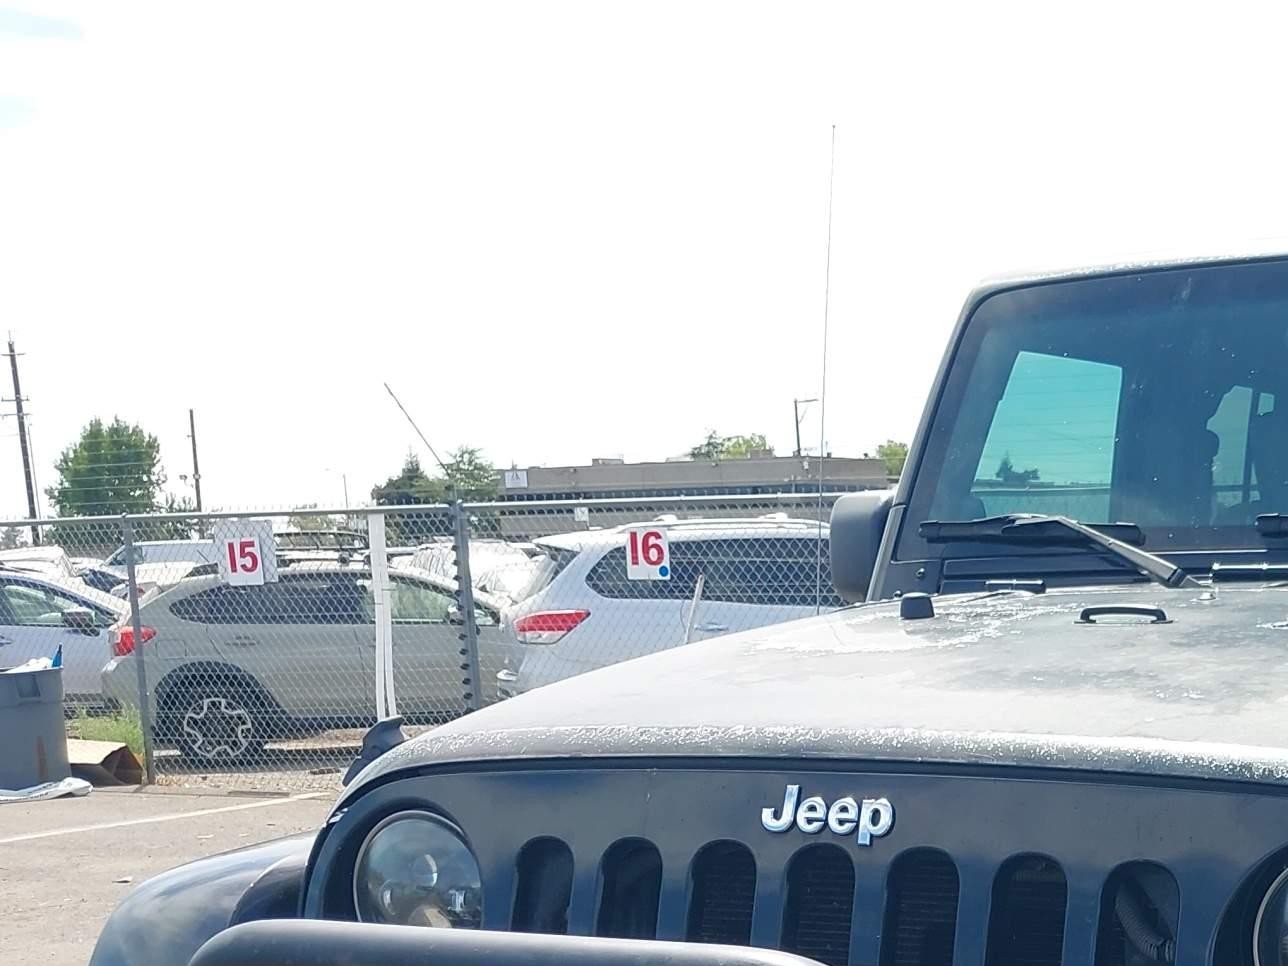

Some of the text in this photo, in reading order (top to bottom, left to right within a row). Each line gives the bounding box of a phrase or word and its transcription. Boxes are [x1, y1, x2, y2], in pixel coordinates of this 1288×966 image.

[228, 540, 259, 573] 15
[630, 531, 665, 566] 16
[761, 784, 893, 846] Jeep
